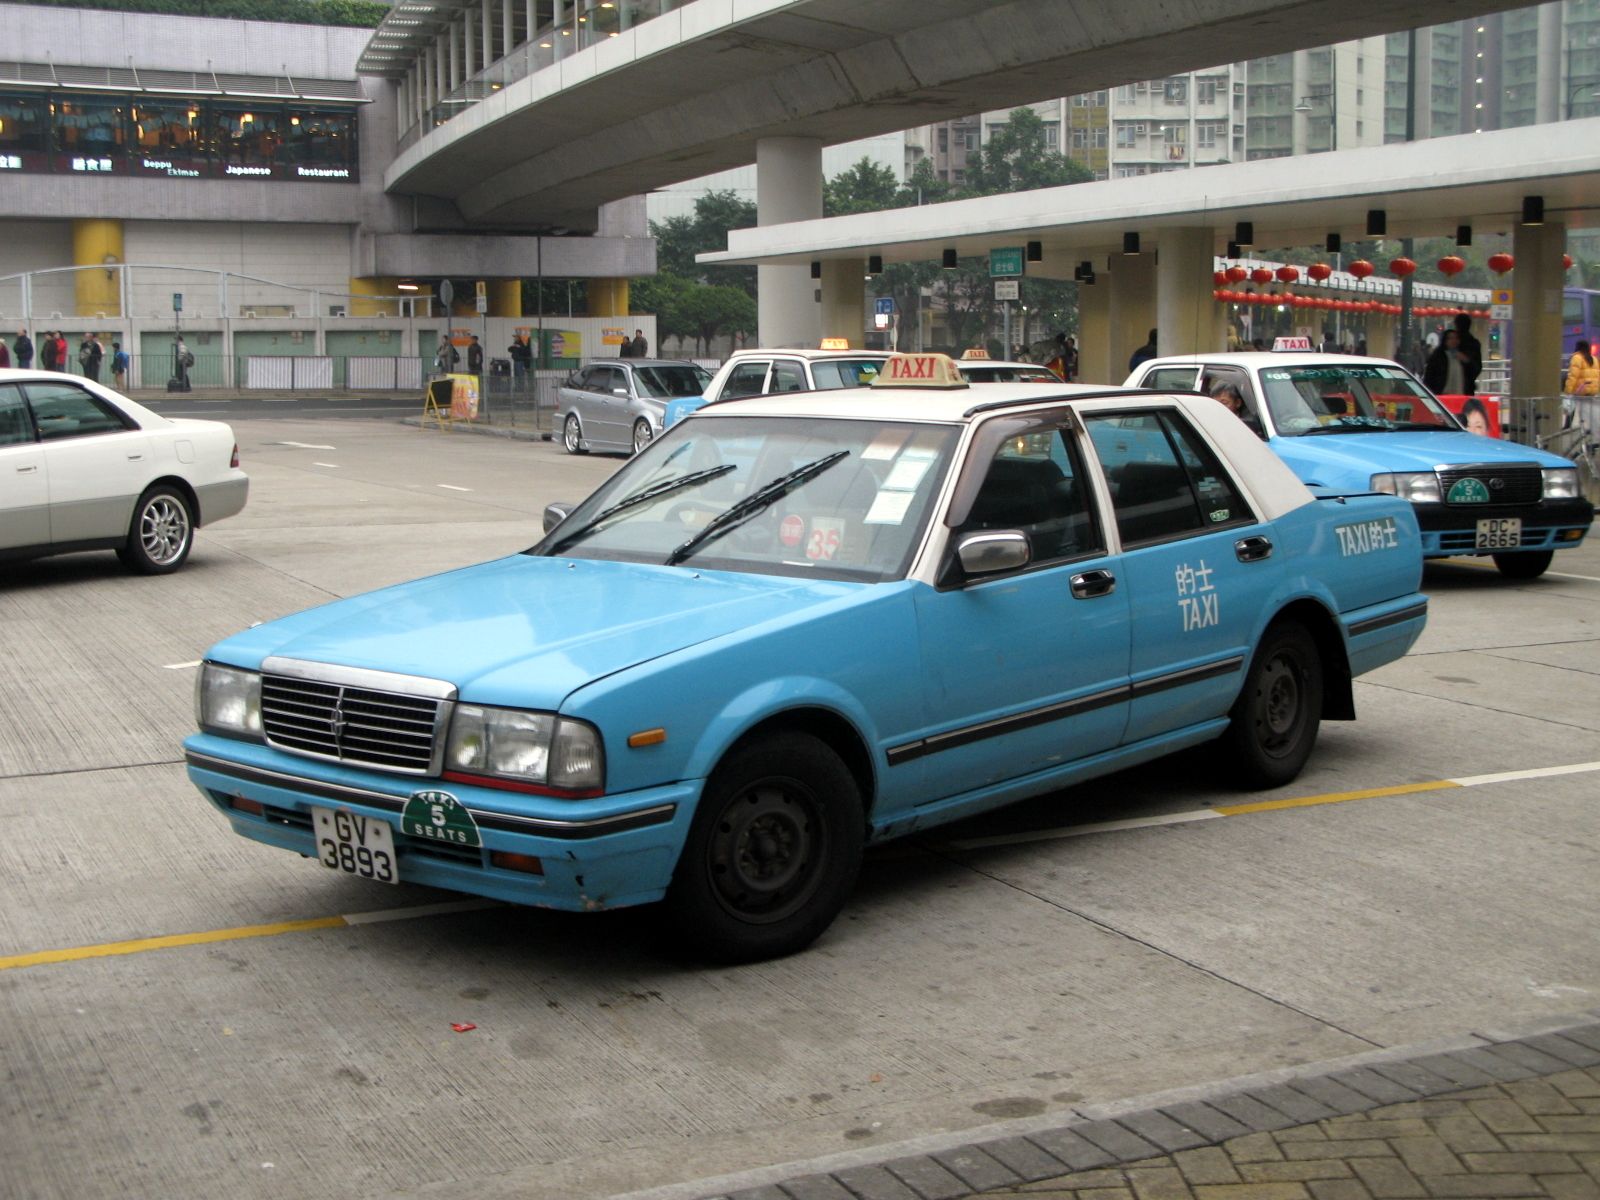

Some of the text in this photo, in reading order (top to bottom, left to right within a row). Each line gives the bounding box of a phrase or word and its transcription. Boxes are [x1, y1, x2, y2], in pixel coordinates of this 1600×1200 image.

[143, 159, 172, 169] Beppu
[225, 165, 349, 177] Japanese Restaurant
[1282, 339, 1308, 349] TAXI
[969, 350, 985, 358] TAXI
[890, 357, 936, 378] TAXI
[1465, 486, 1473, 496] 5
[1489, 520, 1509, 533] DC
[1479, 533, 1518, 547] 2665
[1175, 559, 1215, 597] 的士
[1178, 593, 1219, 632] TAXI
[418, 792, 455, 811] TAXI
[431, 805, 447, 827] 5
[334, 811, 366, 847] GV
[414, 823, 467, 843] SEATS
[322, 838, 392, 882] 3893
